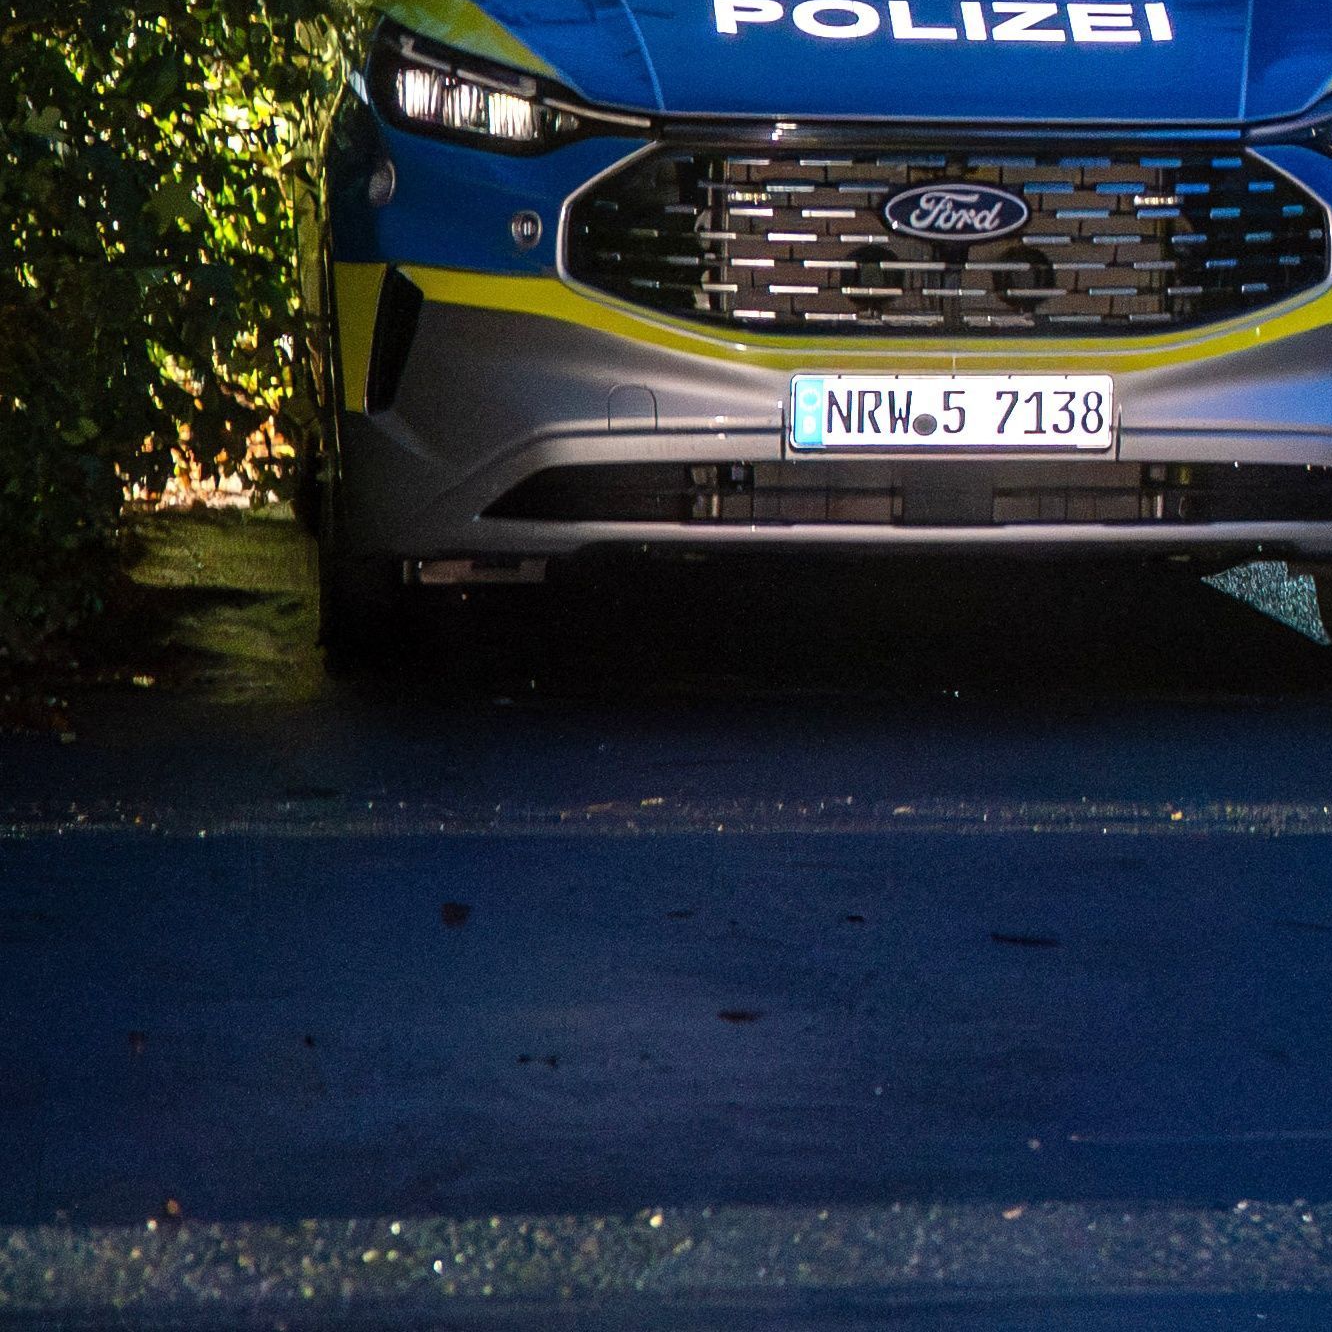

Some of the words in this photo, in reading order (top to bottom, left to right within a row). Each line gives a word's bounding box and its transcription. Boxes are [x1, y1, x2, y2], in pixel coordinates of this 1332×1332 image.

[910, 191, 1002, 230] Ford
[827, 390, 913, 434] NRW
[943, 390, 966, 434] 5
[996, 390, 1104, 435] 7138
